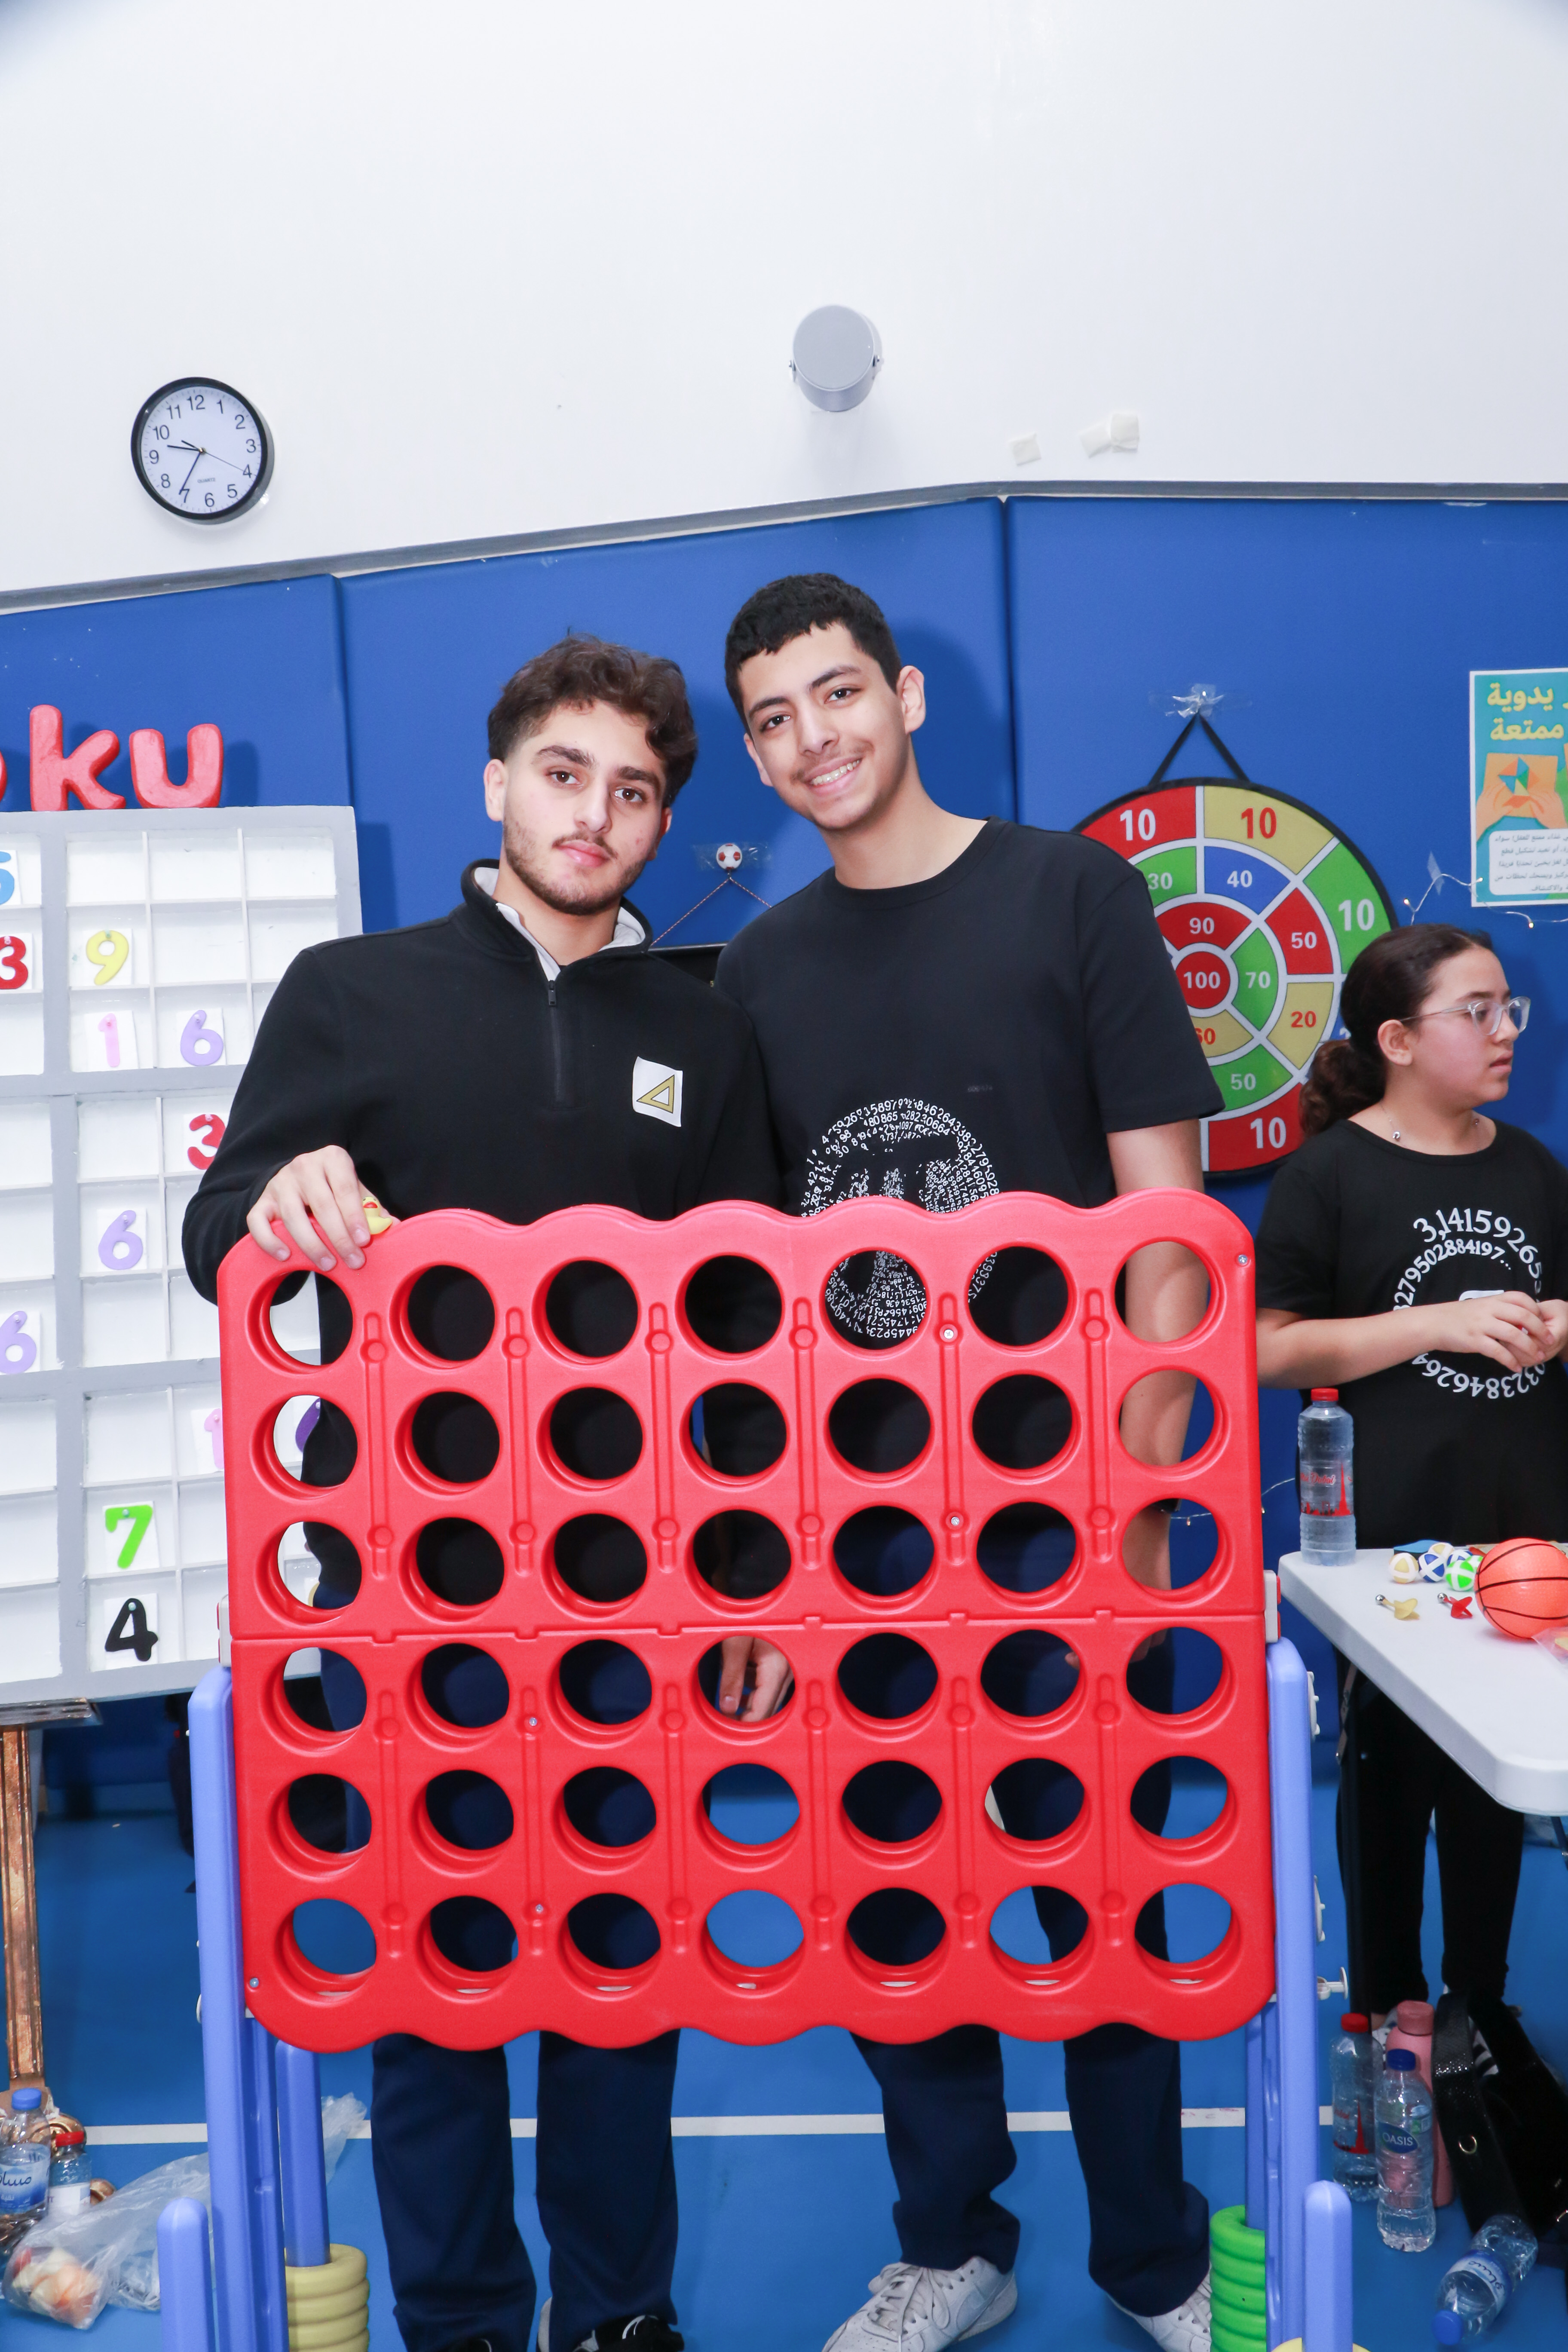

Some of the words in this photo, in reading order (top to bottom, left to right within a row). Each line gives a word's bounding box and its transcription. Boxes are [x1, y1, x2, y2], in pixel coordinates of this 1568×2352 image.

[166, 404, 181, 419] 11
[187, 395, 205, 410] 12
[217, 399, 224, 414] 1
[234, 414, 245, 429] 2
[153, 425, 169, 440] 10
[246, 439, 256, 453] 3
[149, 450, 159, 464] 9
[243, 464, 252, 478] 4
[161, 473, 171, 488] 8
[181, 488, 190, 503] 7
[205, 493, 214, 507] 6
[227, 484, 237, 498] 5
[1488, 683, 1554, 712] يدوية
[1491, 717, 1564, 740] ممتعة
[1120, 808, 1156, 841] 10
[1240, 807, 1277, 839] 10
[1148, 873, 1173, 891] 30
[1227, 870, 1253, 888] 40
[1338, 899, 1375, 931] 10
[1189, 917, 1215, 935] 90
[1291, 931, 1317, 950] 50
[86, 930, 129, 985] 9
[1183, 971, 1221, 989] 100
[1246, 971, 1271, 989] 70
[1291, 1010, 1317, 1029] 20
[98, 1013, 120, 1067] 1
[181, 1010, 223, 1066] 6
[1230, 1073, 1256, 1091] 50
[1250, 1116, 1286, 1149] 10
[187, 1114, 227, 1170] 3
[98, 1210, 143, 1270] 6
[0, 1311, 37, 1374] 6
[105, 1504, 153, 1569] 7
[105, 1598, 158, 1661] 4
[1382, 2132, 1413, 2146] OASIS
